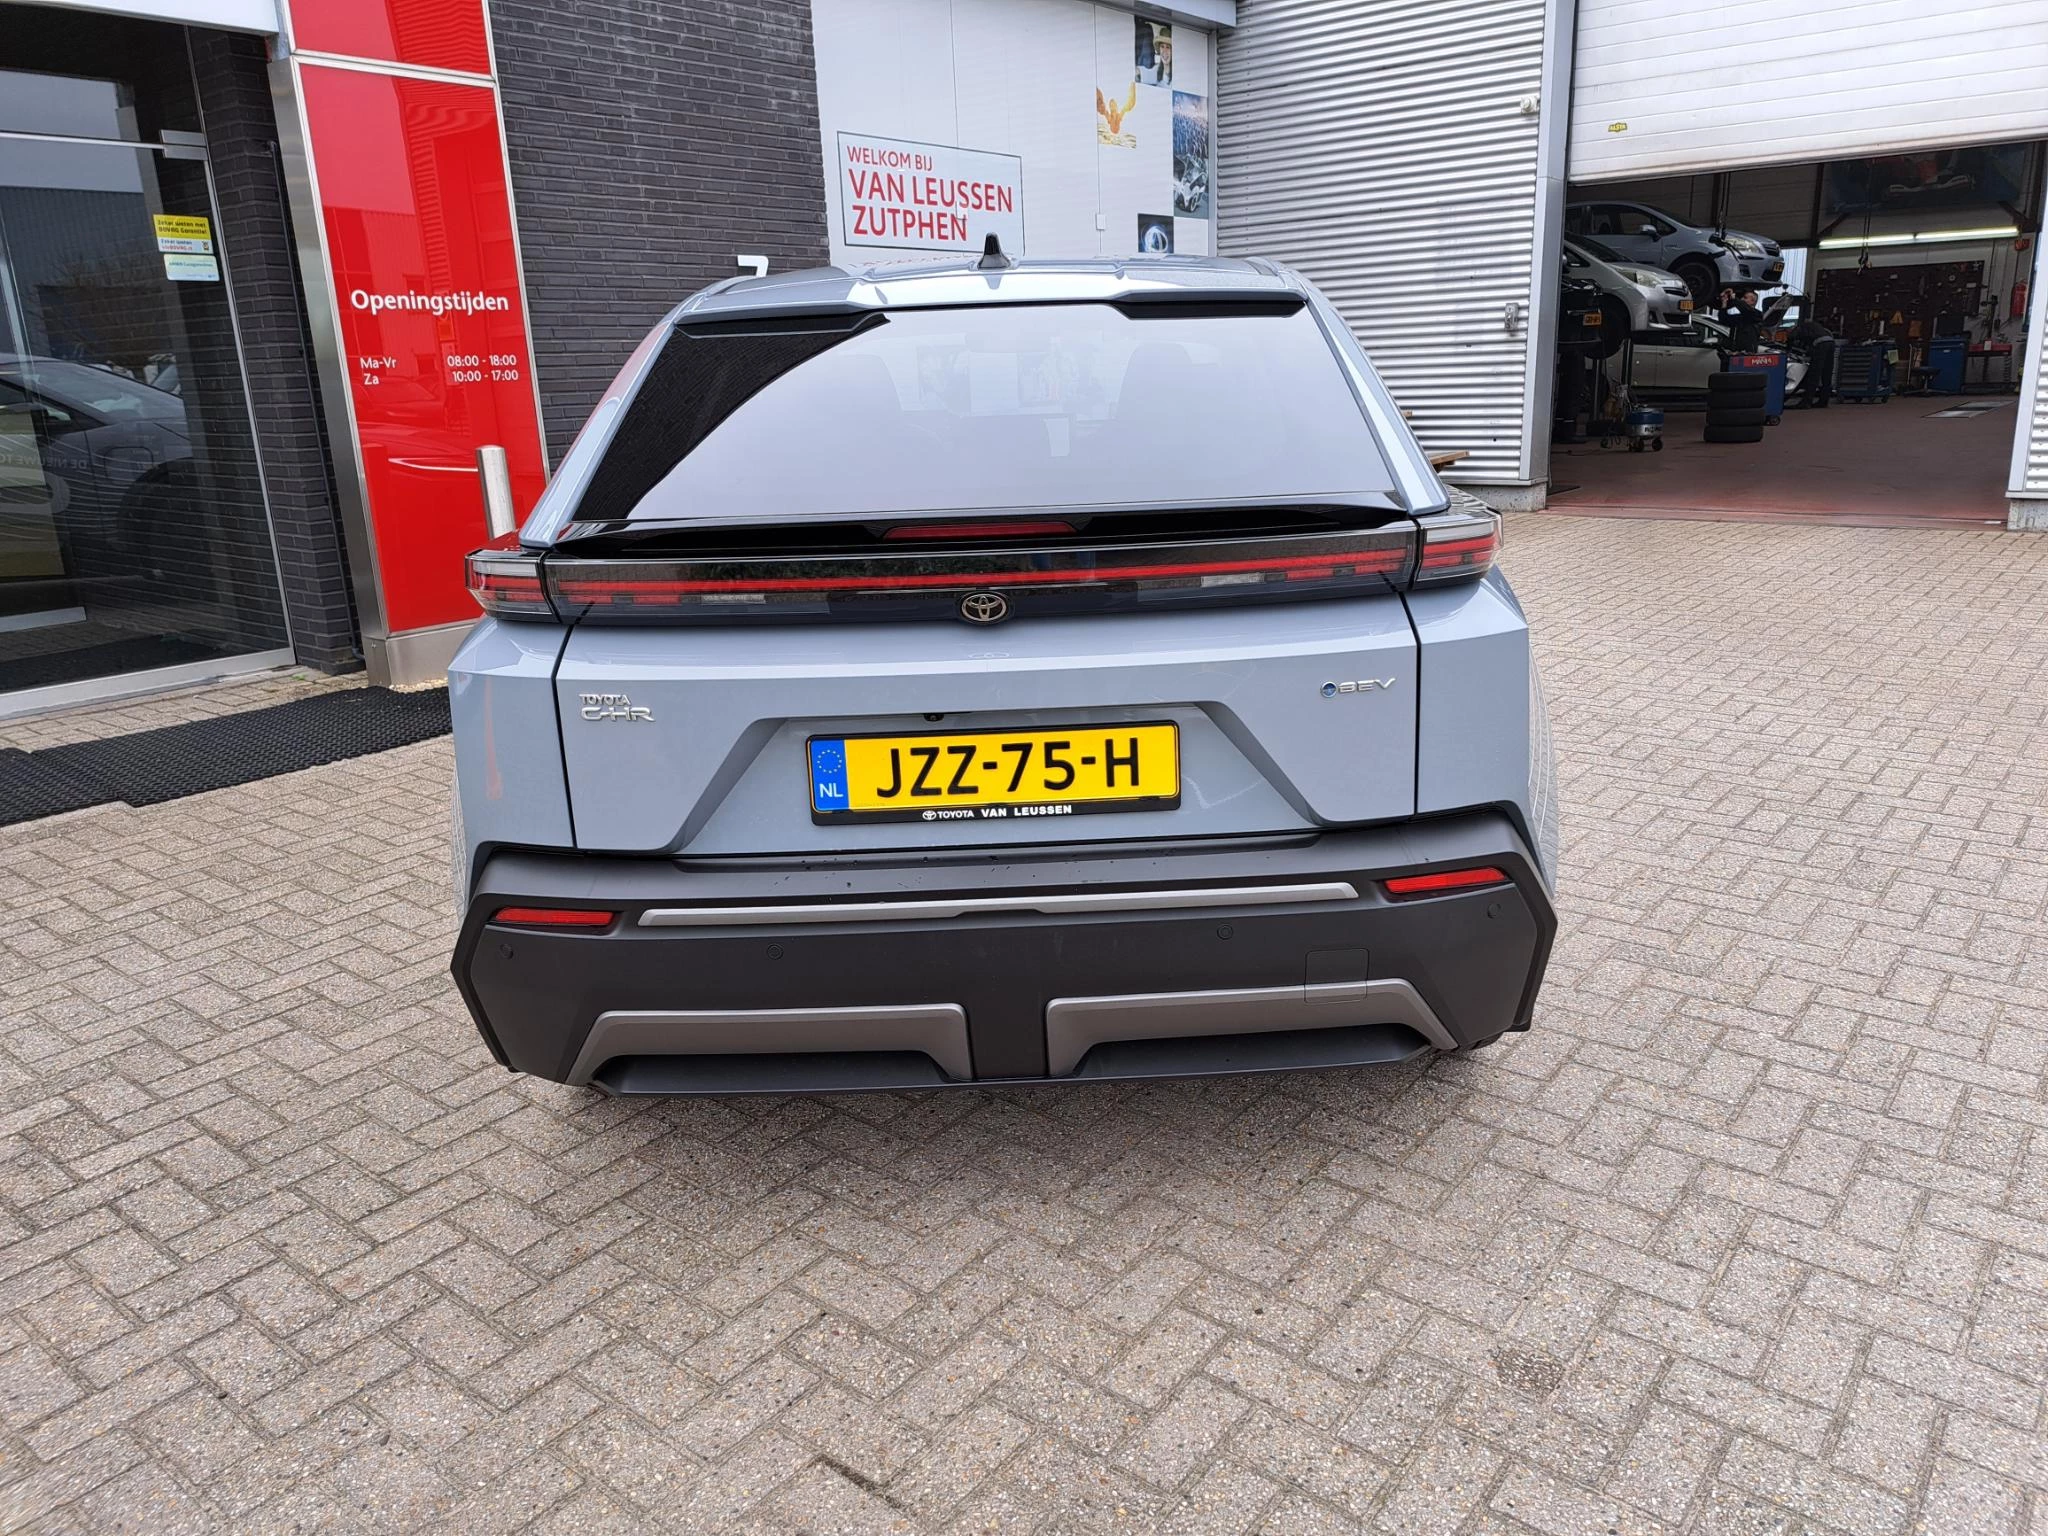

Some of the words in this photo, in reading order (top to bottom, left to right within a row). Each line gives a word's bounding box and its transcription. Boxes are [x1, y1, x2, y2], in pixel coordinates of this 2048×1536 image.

[847, 146, 911, 168] WELKOM
[915, 154, 932, 172] BIJ
[848, 168, 905, 203] VAN
[912, 176, 1013, 213] LEUSSEN
[852, 205, 967, 241] ZUTPHEN
[351, 289, 509, 316] Openingstijden
[360, 357, 397, 369] Ma-Vr
[447, 355, 479, 367] 08:00
[489, 354, 517, 366] 18:00
[364, 373, 380, 385] Za
[452, 370, 481, 382] 10:00
[491, 369, 519, 381] 17:00
[1339, 678, 1396, 693] BEV
[578, 693, 632, 705] TOYOTA
[581, 706, 656, 722] C-HR
[876, 737, 1140, 799] JZZ-75-H
[819, 783, 843, 798] NL
[937, 810, 975, 819] TOYOTA
[981, 808, 1008, 818] VAN
[1014, 804, 1073, 816] LEUSSEN
